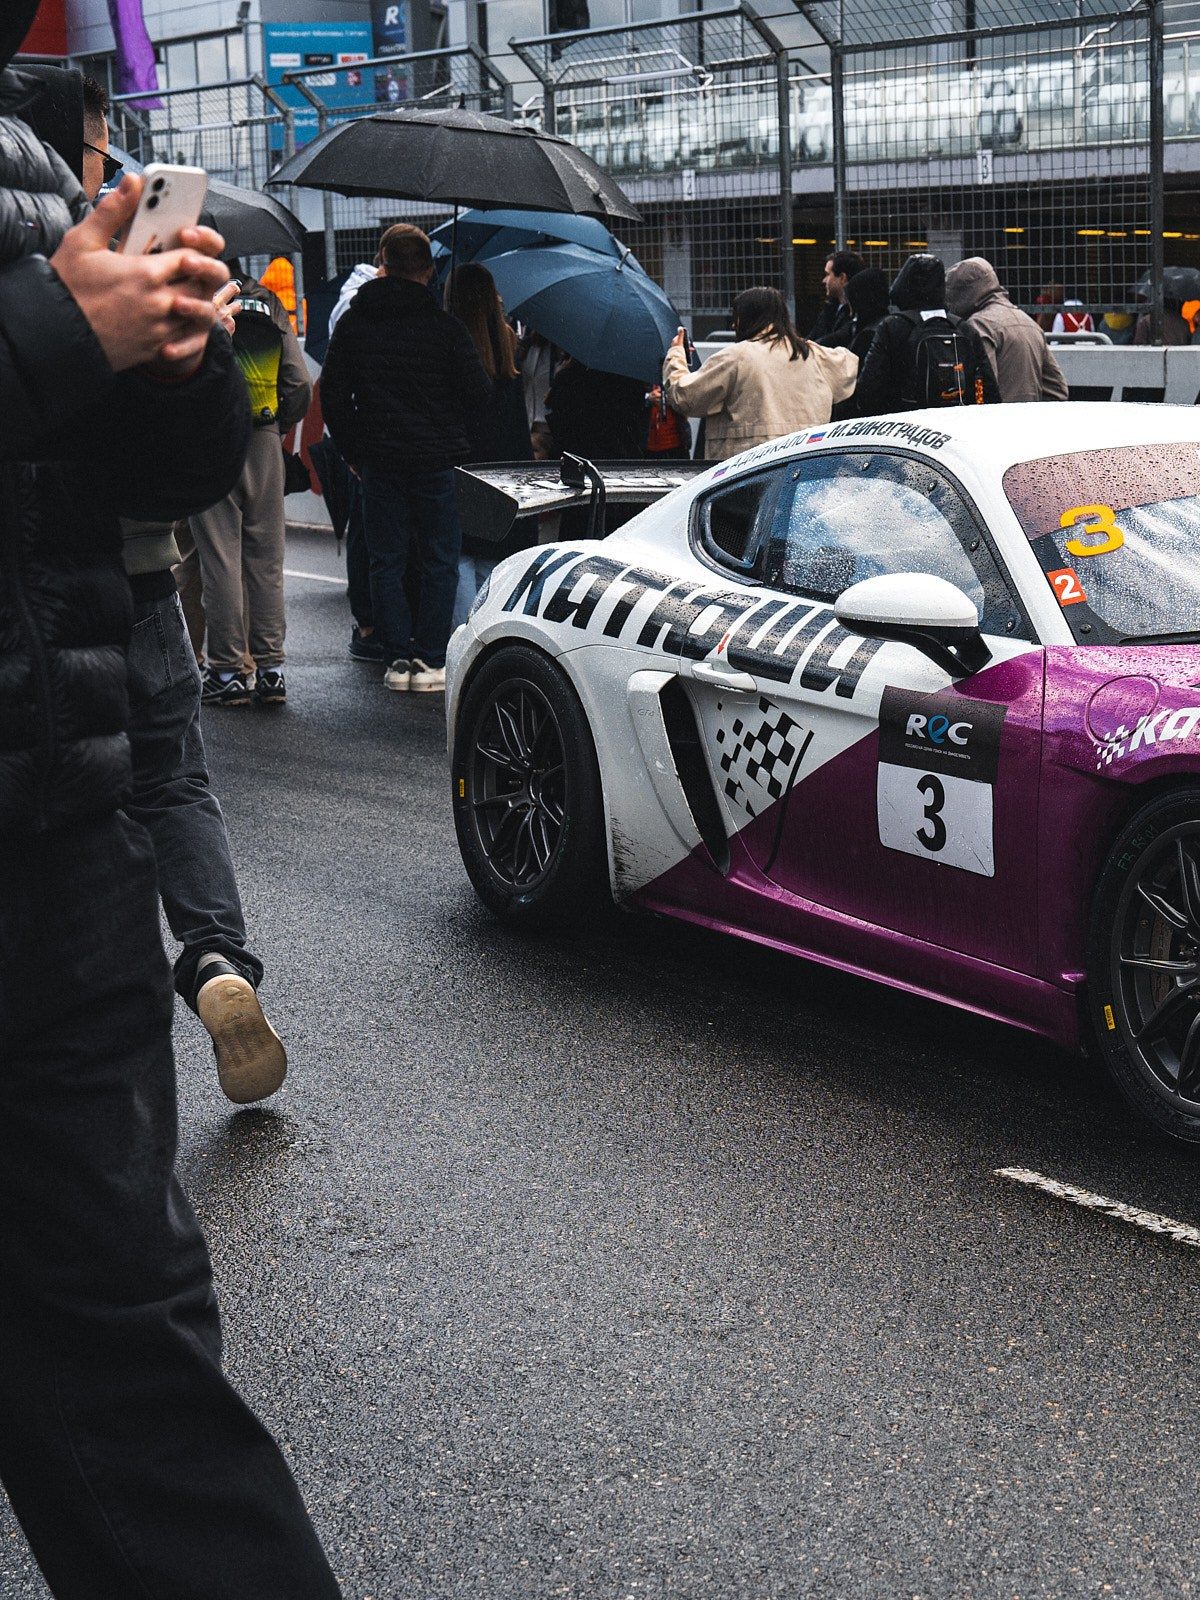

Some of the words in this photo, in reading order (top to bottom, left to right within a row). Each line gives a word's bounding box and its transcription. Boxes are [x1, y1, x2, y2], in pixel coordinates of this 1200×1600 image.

[981, 155, 989, 180] 3
[1060, 504, 1125, 557] 3
[1054, 574, 1082, 601] 2
[916, 773, 947, 852] 3
